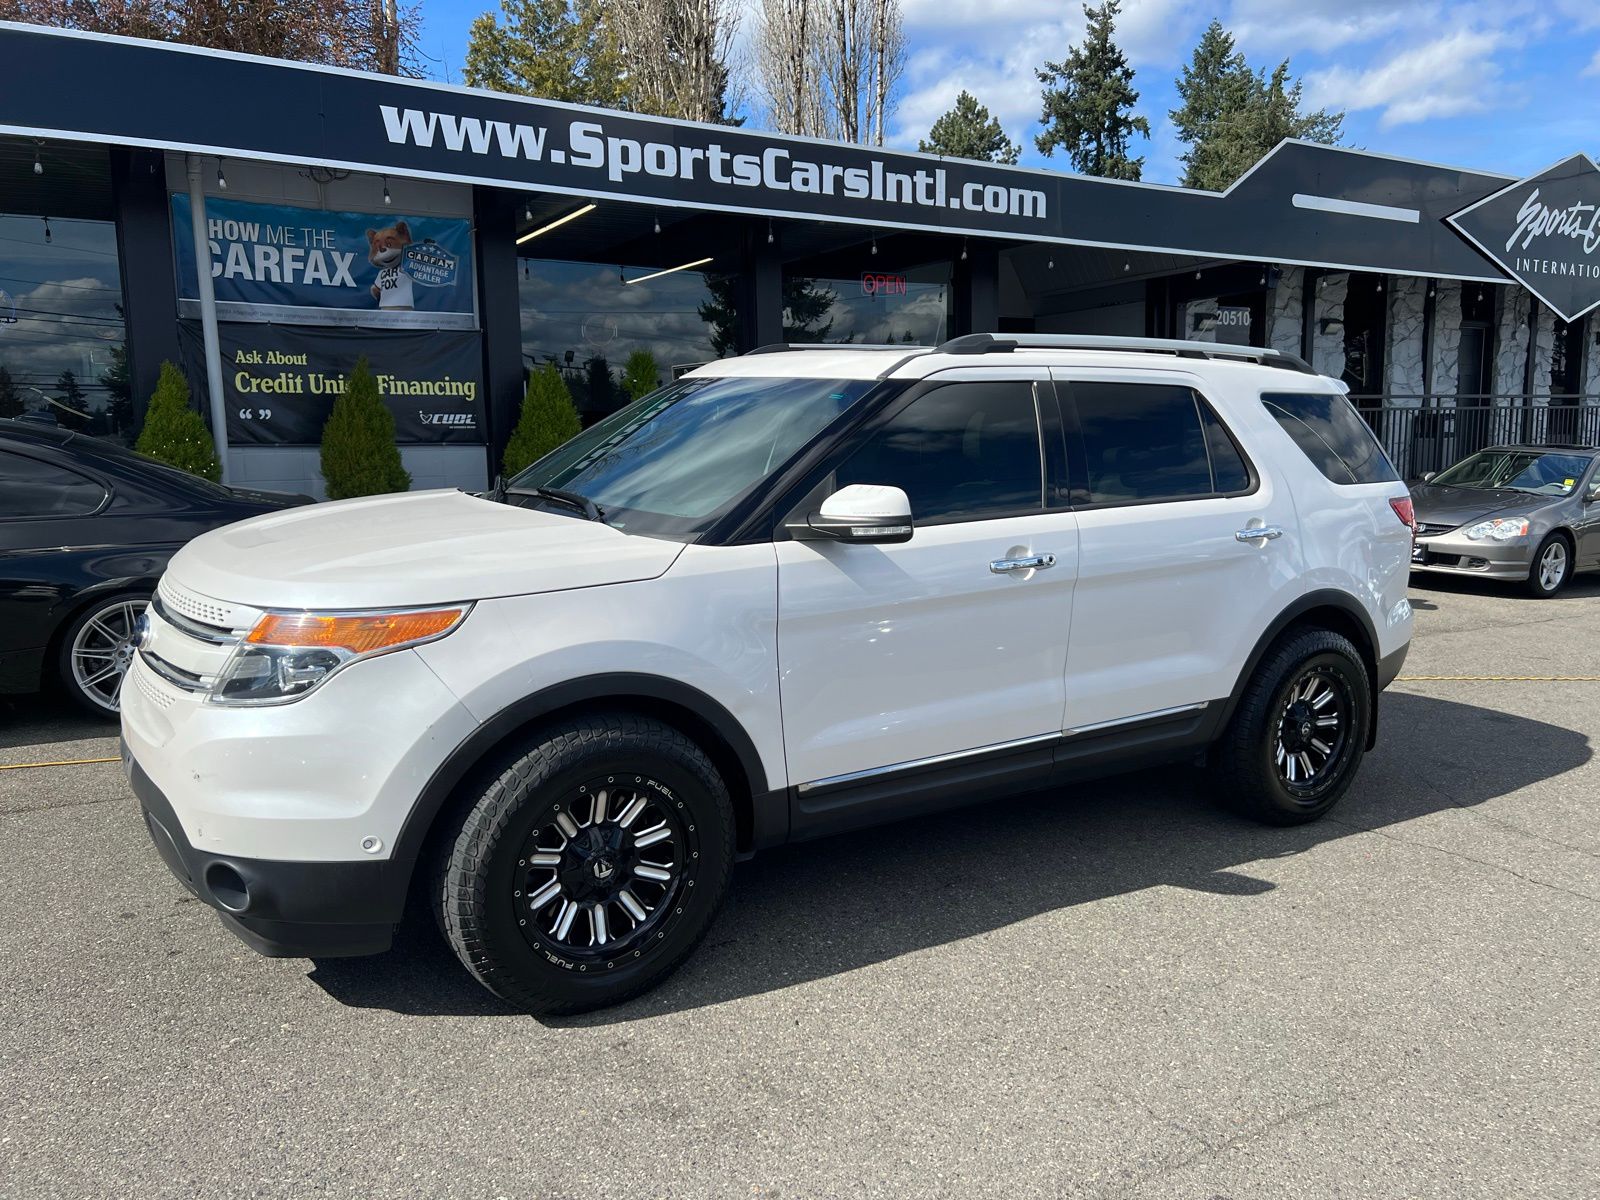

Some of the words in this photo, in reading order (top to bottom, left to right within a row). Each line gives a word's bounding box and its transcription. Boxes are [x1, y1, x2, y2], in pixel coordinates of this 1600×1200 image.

[379, 105, 1047, 219] www.SportsCarsIntl.com
[208, 218, 260, 243] HOW
[266, 224, 296, 246] ME
[300, 228, 336, 249] THE
[208, 240, 358, 288] CARFAX
[407, 251, 454, 270] CARFAX
[409, 262, 449, 278] ADVANTAGE
[1516, 258, 1600, 279] INTERNATIO
[380, 267, 399, 279] CAR
[413, 271, 441, 283] DEALER
[381, 278, 398, 290] FOX
[863, 274, 906, 295] OPEN
[1216, 310, 1250, 326] 20510
[235, 350, 263, 364] Ask
[266, 351, 307, 366] About
[235, 371, 304, 394] Credit
[308, 374, 351, 395] Uni
[376, 375, 475, 401] Financing
[647, 779, 673, 800] FUEL
[545, 950, 574, 970] FUEL
